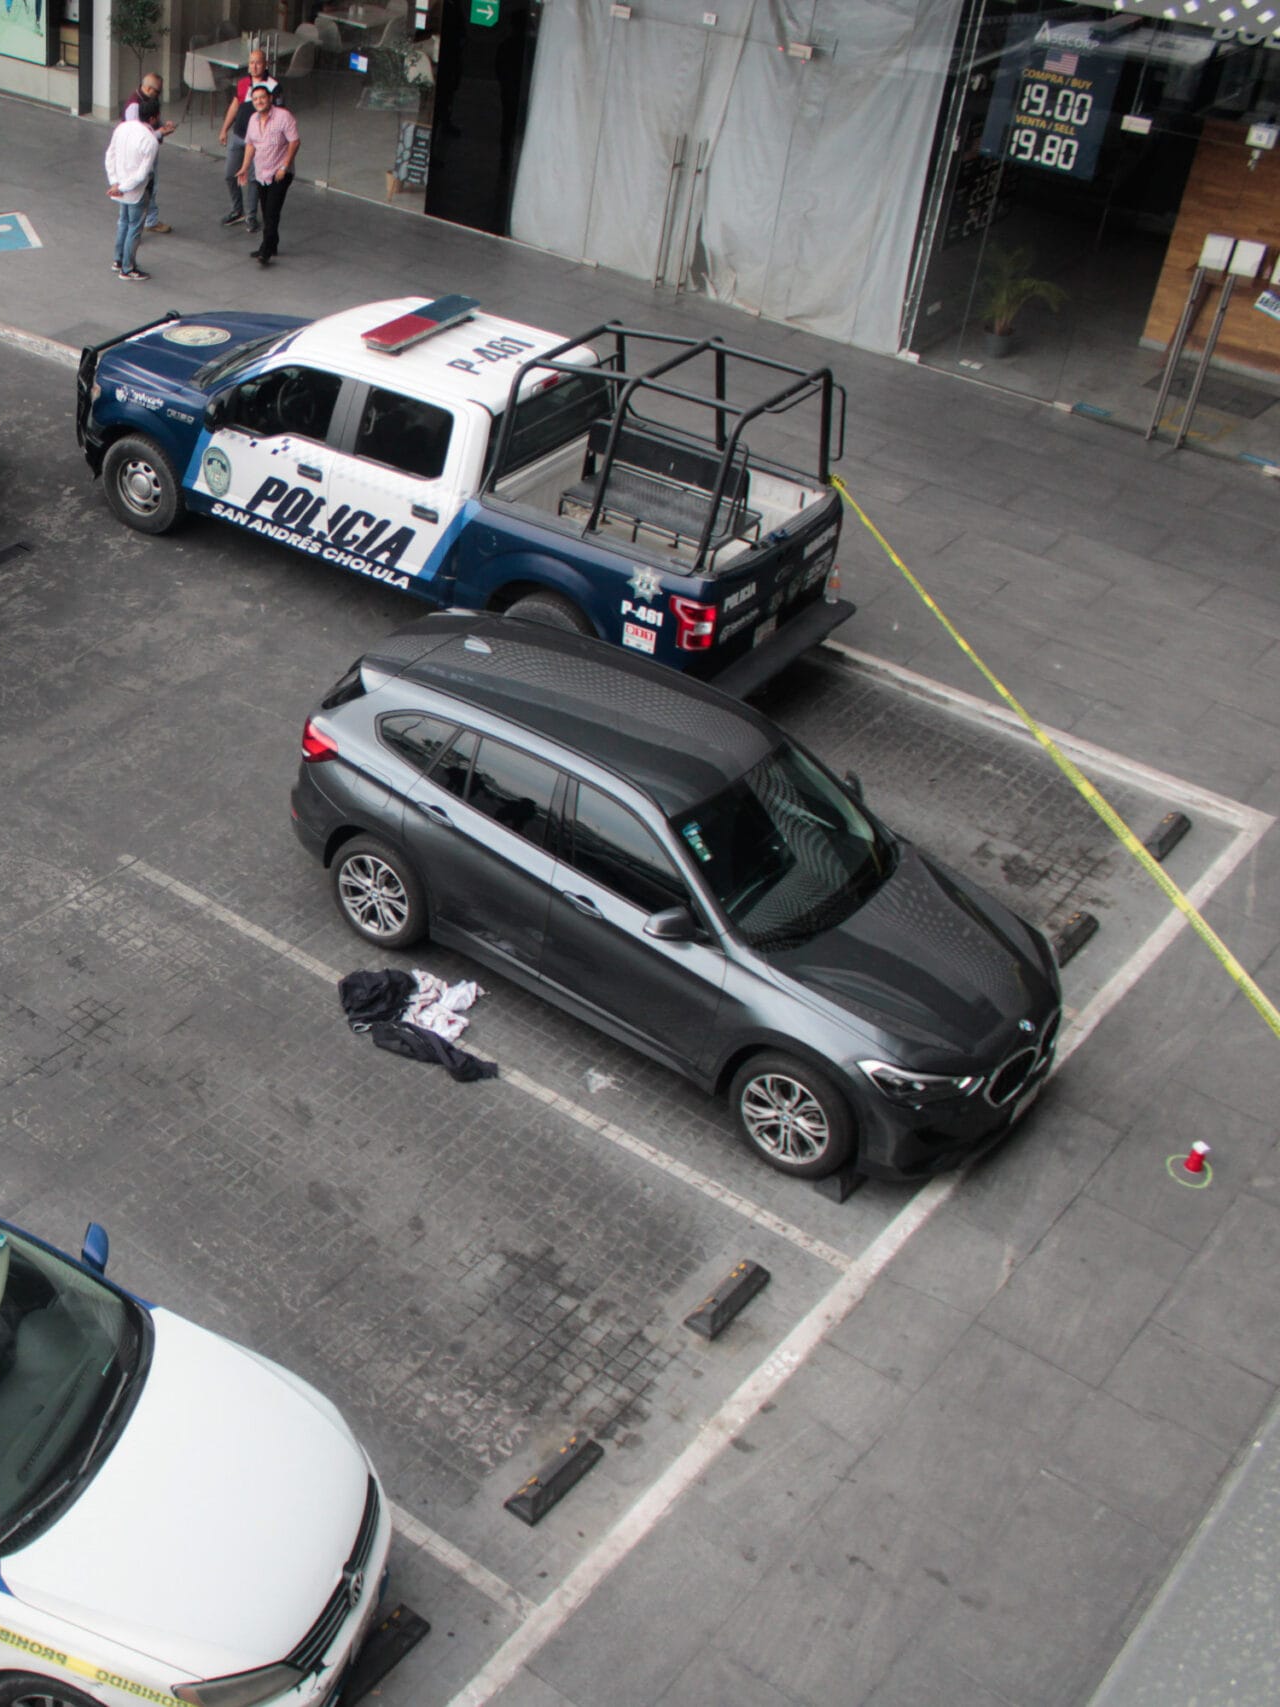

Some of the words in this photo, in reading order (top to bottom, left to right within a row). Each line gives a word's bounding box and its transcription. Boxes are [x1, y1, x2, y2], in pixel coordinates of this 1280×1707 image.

[1023, 68, 1064, 84] COMPRA
[1071, 78, 1093, 90] BUY
[1015, 115, 1047, 129] VENTA
[1054, 123, 1076, 136] SELL
[1021, 84, 1093, 126] 19.00
[1009, 128, 1079, 171] 19.80
[446, 335, 535, 376] P-461
[246, 476, 416, 567] POLICIA
[211, 502, 250, 523] SAN
[249, 516, 322, 554] ANDRÉS
[322, 548, 410, 590] CHOLULA
